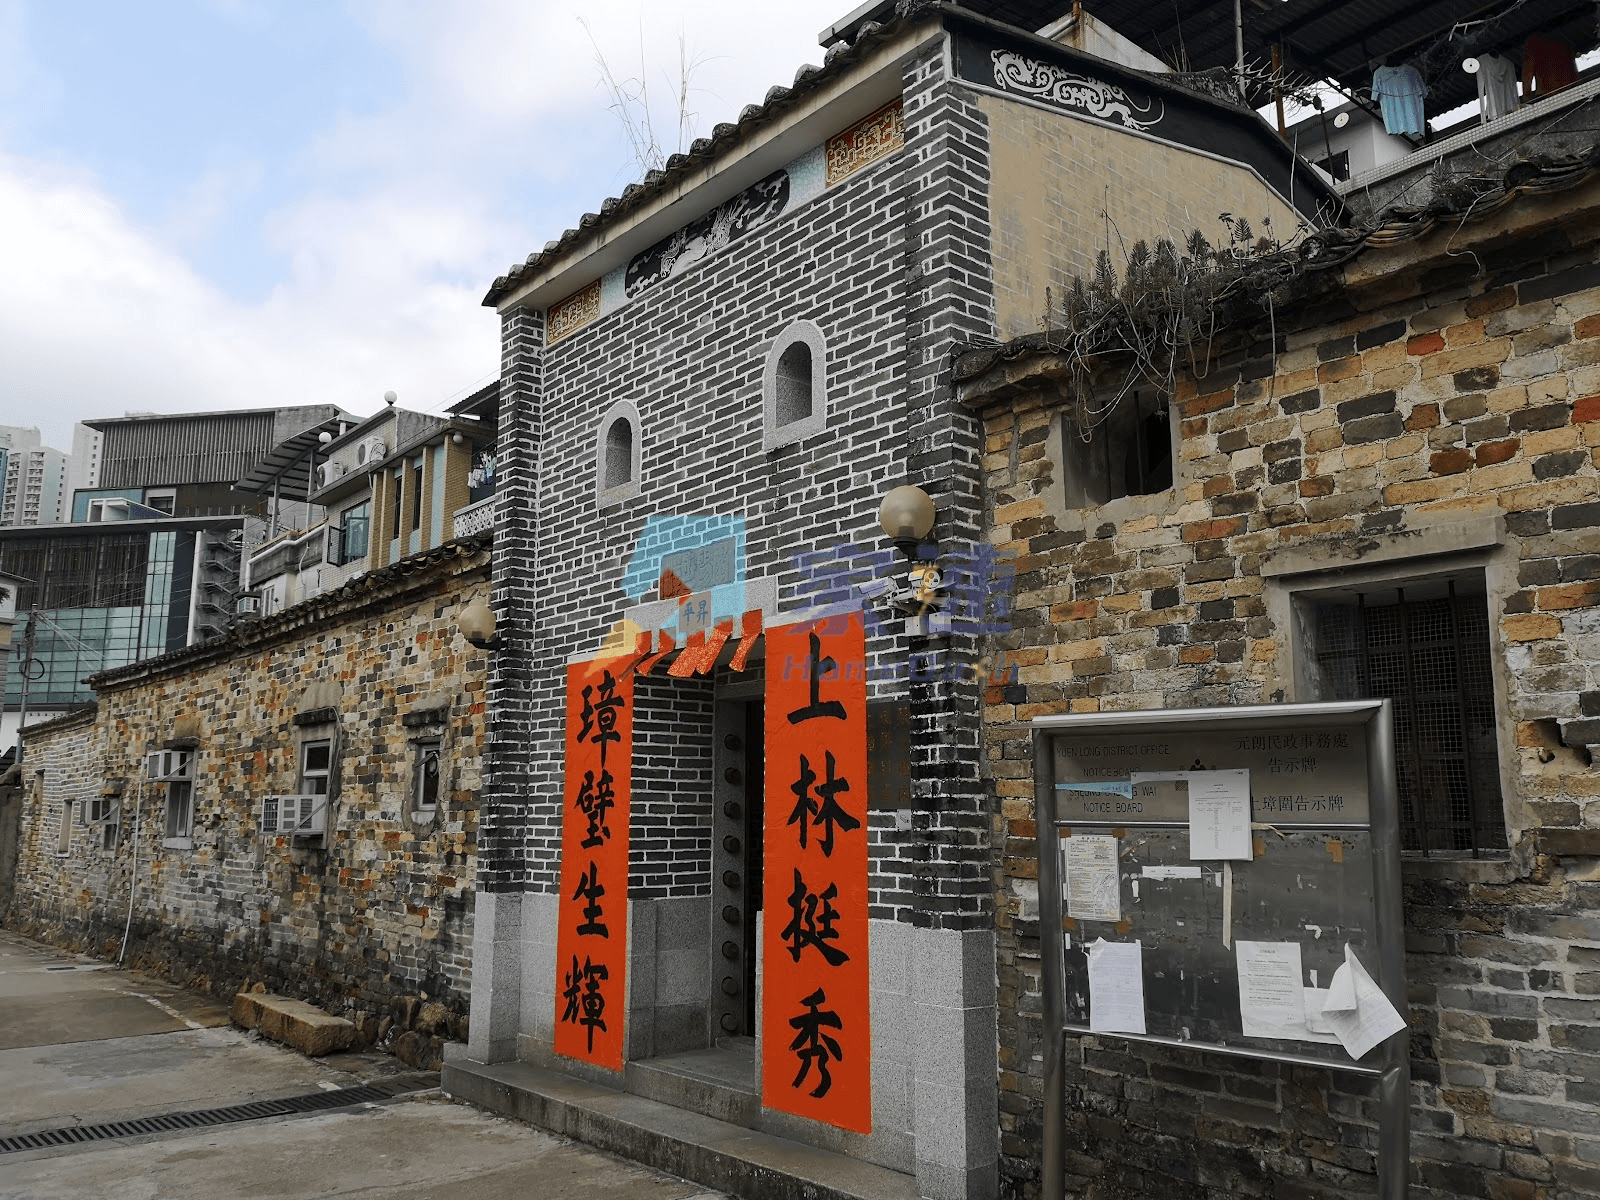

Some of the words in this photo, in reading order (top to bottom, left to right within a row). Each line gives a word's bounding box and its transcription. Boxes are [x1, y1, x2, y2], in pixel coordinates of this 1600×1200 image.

[1235, 732, 1349, 751] 元朗民政事務處
[1056, 747, 1078, 758] YUEN
[1080, 746, 1101, 757] LONG
[1104, 745, 1139, 756] DISTRICT
[1140, 744, 1170, 755] OFFICE
[1083, 767, 1112, 777] NOTICE
[1268, 756, 1317, 774] 告示牌
[1142, 786, 1157, 797] WAI
[1083, 802, 1111, 813] NOTICE
[1116, 802, 1143, 813] BOARD
[561, 670, 625, 1054] 璋璧生輝
[781, 632, 861, 1098] 上林挺秀
